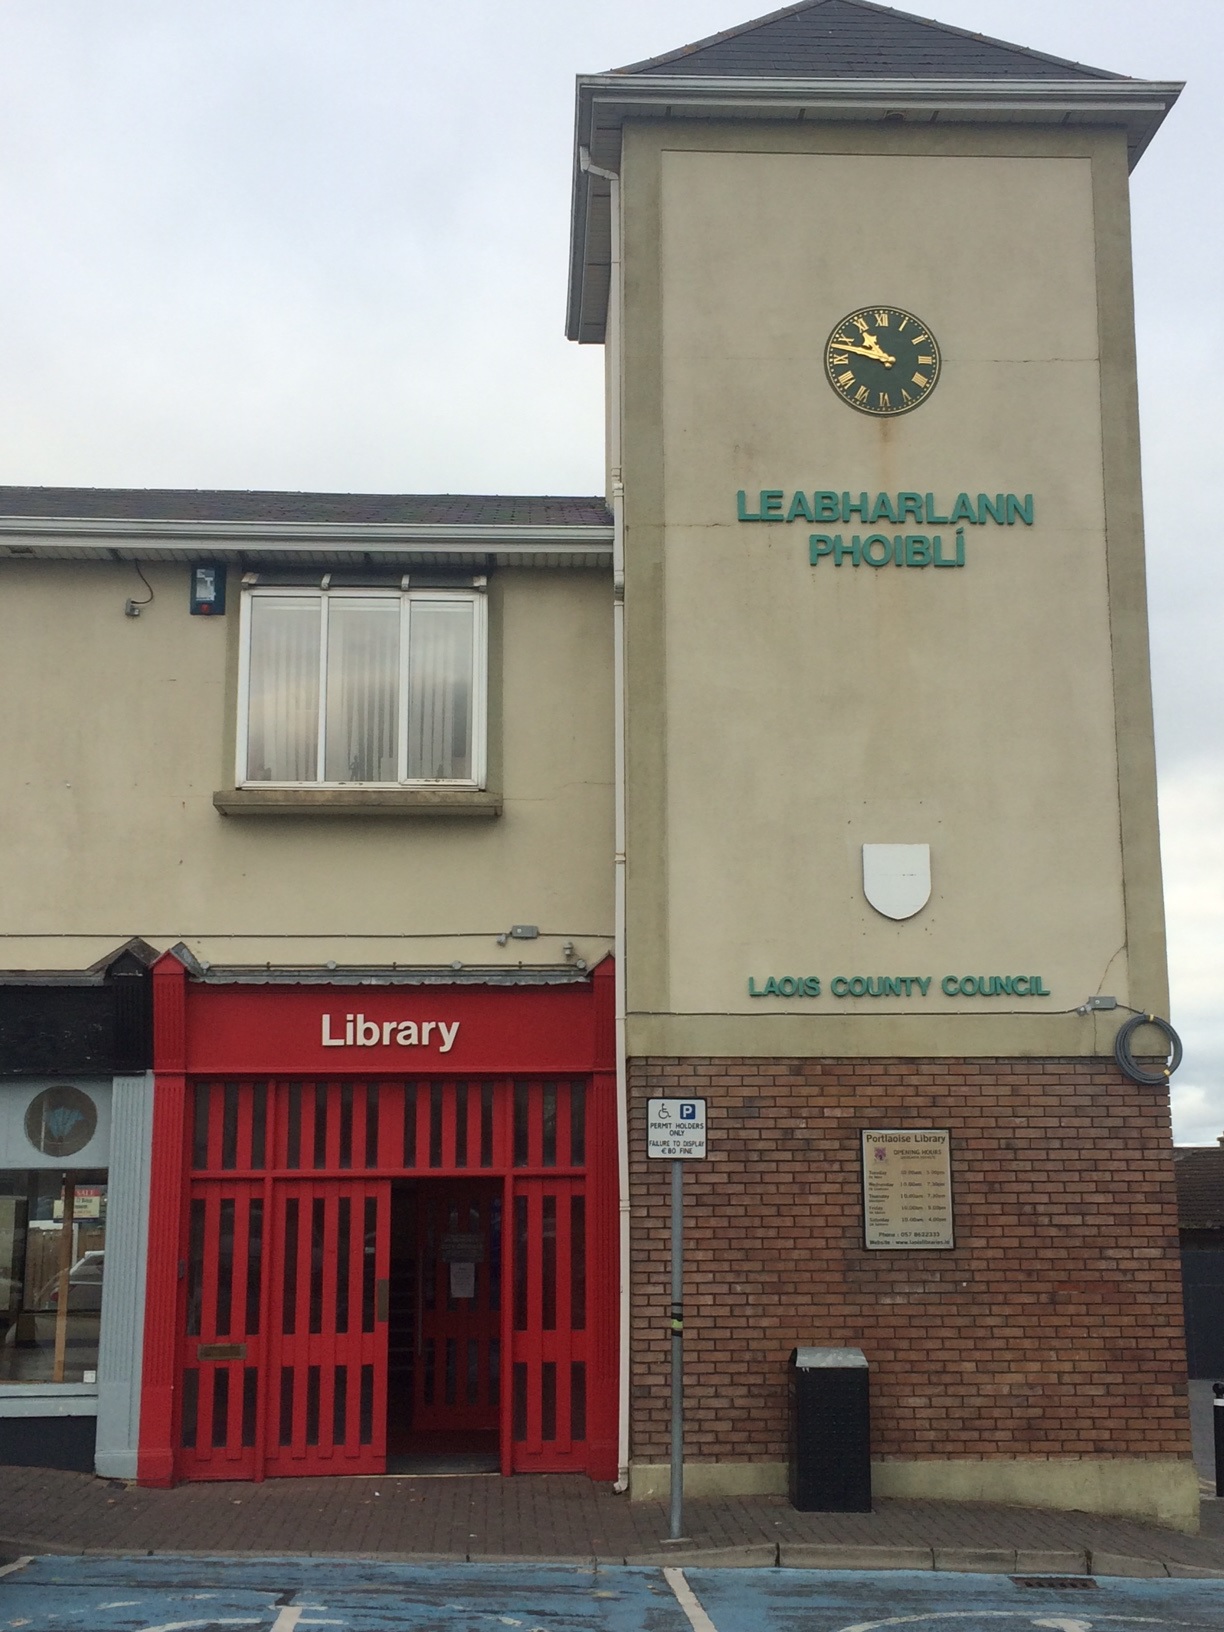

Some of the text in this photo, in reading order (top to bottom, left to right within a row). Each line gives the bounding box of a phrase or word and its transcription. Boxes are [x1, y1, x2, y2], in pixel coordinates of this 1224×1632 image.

[853, 318, 869, 333] XI
[875, 314, 888, 326] XII
[912, 335, 926, 345] II
[834, 354, 848, 364] IX
[918, 356, 932, 364] III
[838, 371, 856, 389] VIII
[855, 386, 870, 403] VII
[879, 393, 890, 406] VI
[901, 389, 911, 402] V
[736, 490, 1034, 526] LEABHARLANN
[809, 527, 966, 568] PHOIBLÍ
[748, 975, 1050, 997] LAOIS COUNTY COUNCIL
[321, 1014, 460, 1053] Library
[683, 1106, 692, 1117] P
[866, 1134, 946, 1144] Portlaoise Library
